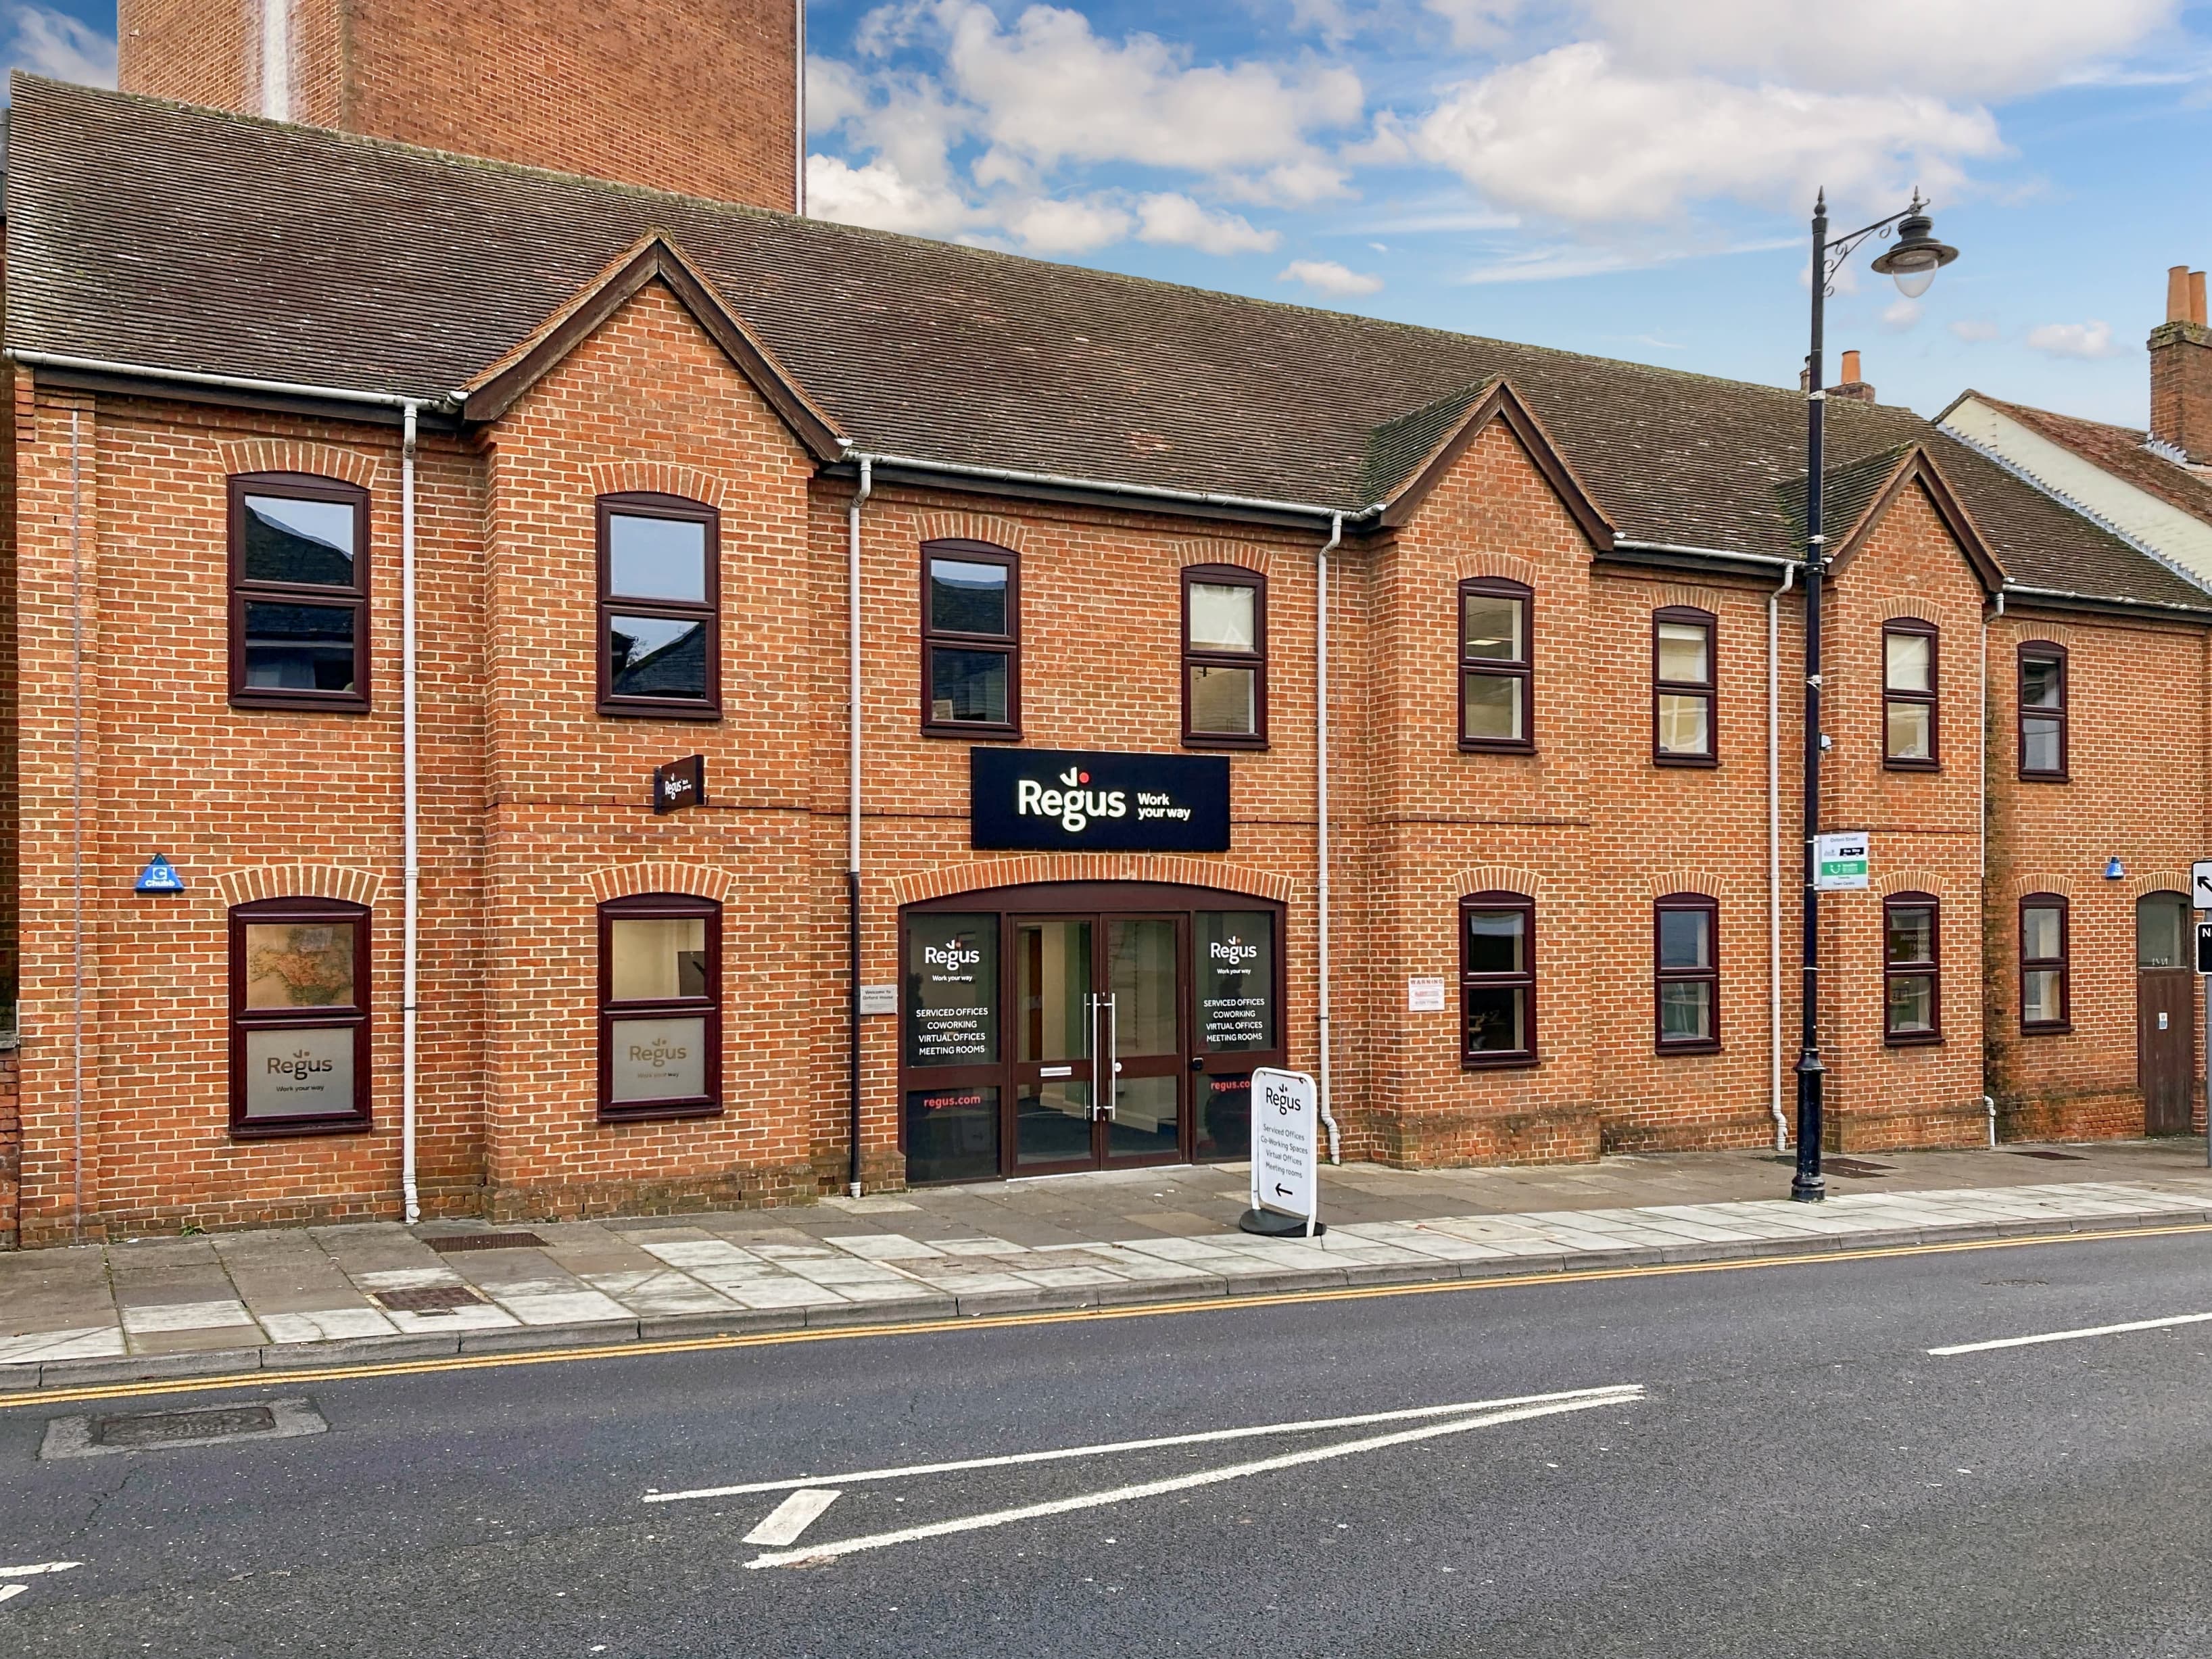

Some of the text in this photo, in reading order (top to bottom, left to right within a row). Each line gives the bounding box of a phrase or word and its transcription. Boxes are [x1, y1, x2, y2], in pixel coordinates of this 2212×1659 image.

[665, 781, 681, 800] Regus
[1138, 792, 1170, 806] Work
[1018, 780, 1126, 832] Regus
[1138, 808, 1191, 821] your way
[2202, 928, 2212, 938] N
[925, 946, 980, 971] Regus
[1211, 942, 1257, 965] Regus
[1203, 999, 1236, 1007] SERVICED
[916, 1007, 988, 1017] SERVICED OFFICES
[1213, 1010, 1255, 1018] COWORKING
[928, 1020, 978, 1030] COWORKING
[1206, 1022, 1234, 1030] VIRTUAL
[918, 1032, 986, 1043] VIRTUAL OFFICES
[1207, 1034, 1236, 1042] MEETING
[629, 1045, 687, 1067] Regus
[919, 1045, 985, 1055] MEETING ROOMS
[267, 1057, 333, 1080] Regus
[1211, 1081, 1250, 1092] regus.co
[923, 1096, 981, 1109] regus.com
[1266, 1087, 1301, 1115] Regus
[1264, 1124, 1305, 1141] Serviced Offices
[1261, 1136, 1308, 1155] Co-Working Spaces
[1266, 1149, 1302, 1165] Virtual Offices
[1266, 1161, 1303, 1178] Meeting rooms
